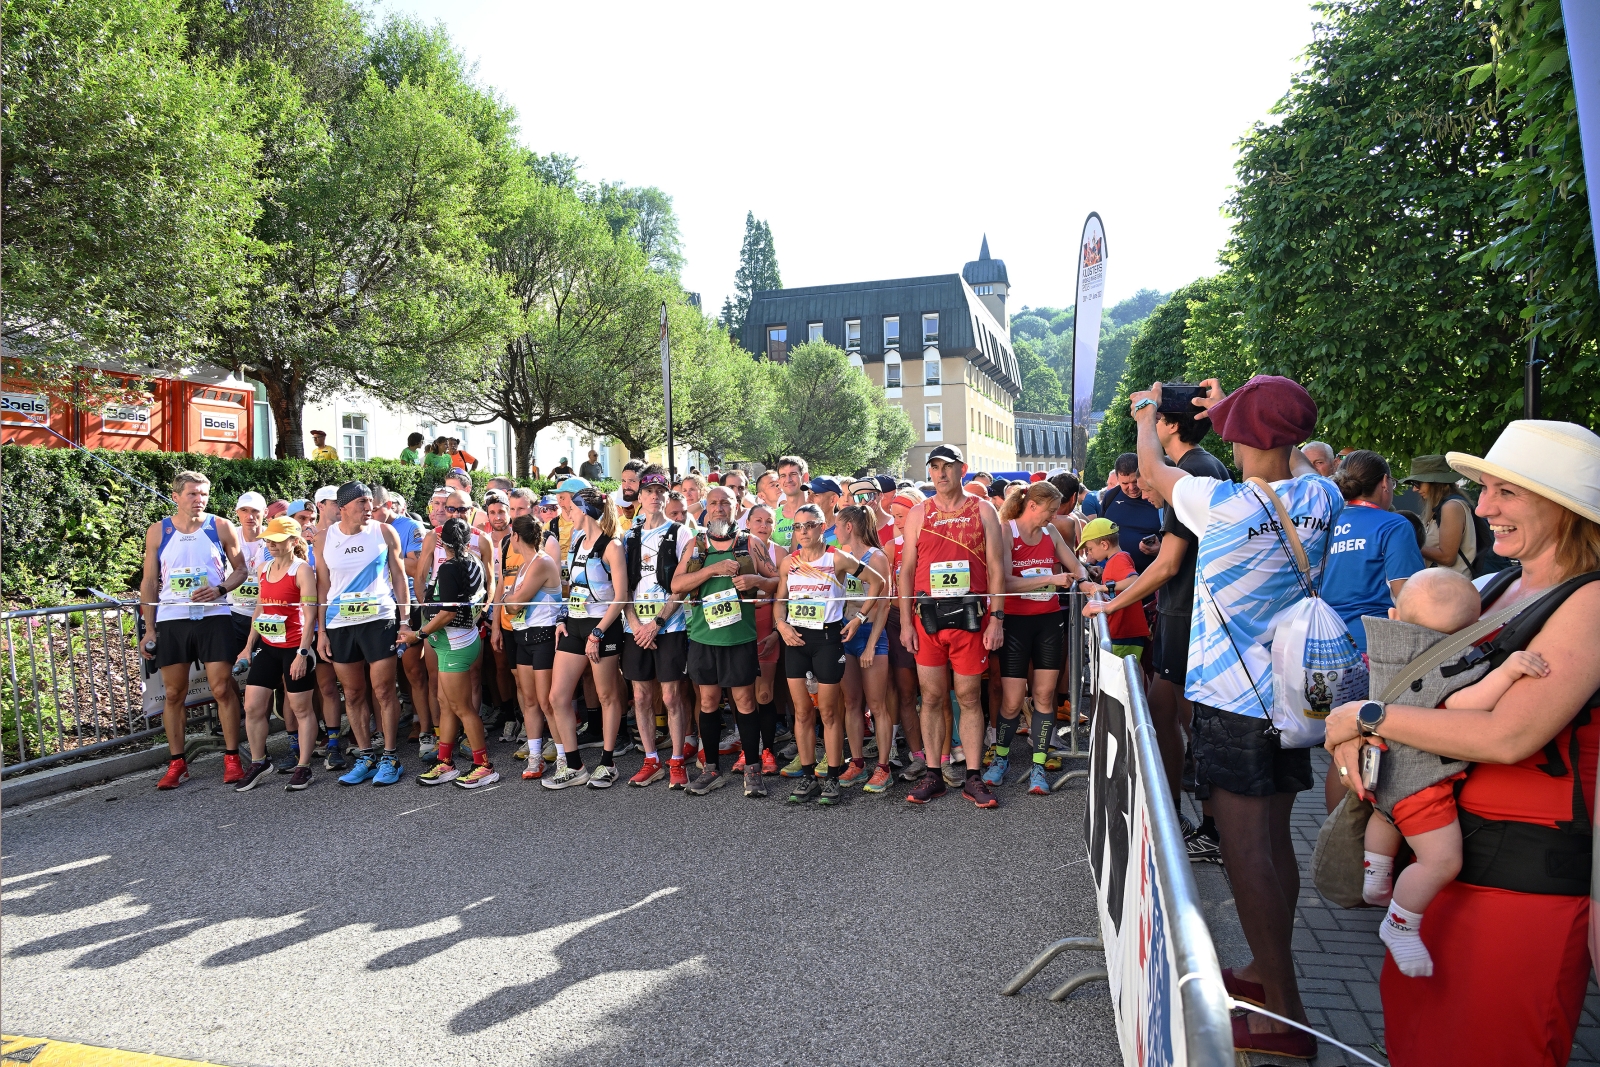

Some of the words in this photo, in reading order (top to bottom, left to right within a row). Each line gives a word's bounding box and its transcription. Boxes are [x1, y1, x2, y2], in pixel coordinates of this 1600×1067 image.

[204, 417, 236, 430] Boels
[1248, 516, 1331, 540] ARGNTINA
[1333, 523, 1352, 537] OC
[344, 545, 365, 555] ARG
[1330, 538, 1367, 555] MBER
[942, 573, 958, 585] 26
[240, 585, 260, 596] 663
[789, 583, 832, 592] ESPAÑA
[638, 604, 656, 615] 211
[711, 601, 733, 616] 498
[794, 605, 817, 617] 203
[258, 622, 278, 633] 564
